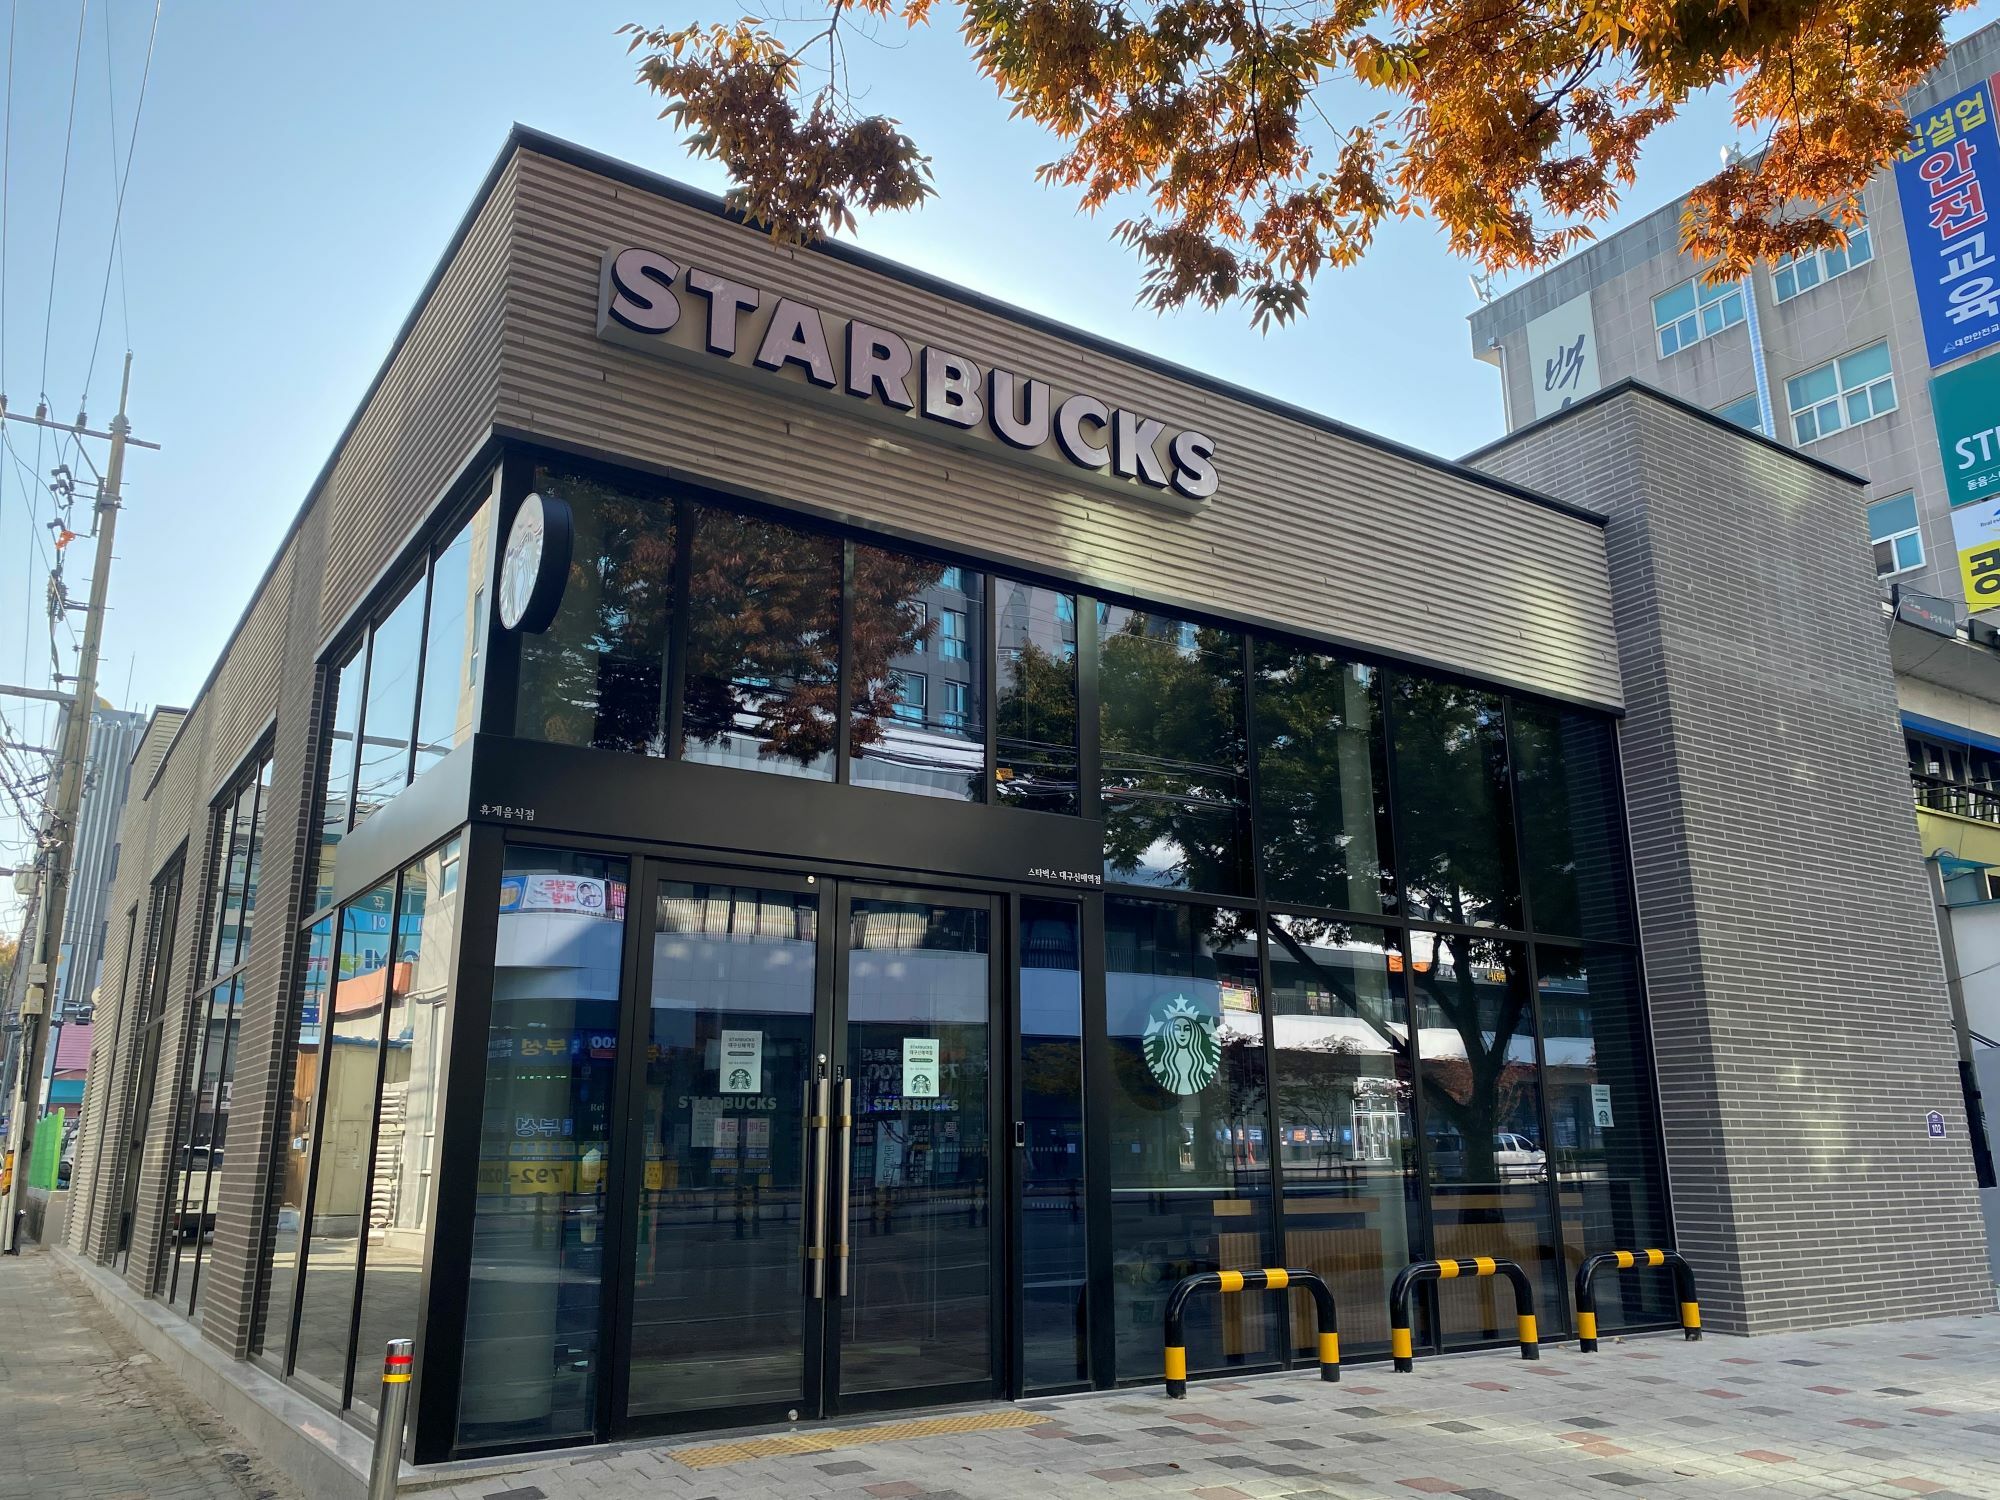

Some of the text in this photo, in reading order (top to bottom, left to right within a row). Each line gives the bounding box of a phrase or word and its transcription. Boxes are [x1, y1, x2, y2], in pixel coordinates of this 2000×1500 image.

[608, 247, 1221, 500] STARBUCKS
[479, 804, 535, 821] 휴게음식점
[1028, 868, 1057, 879] 스타벅스
[873, 1098, 959, 1111] STARBUCKS
